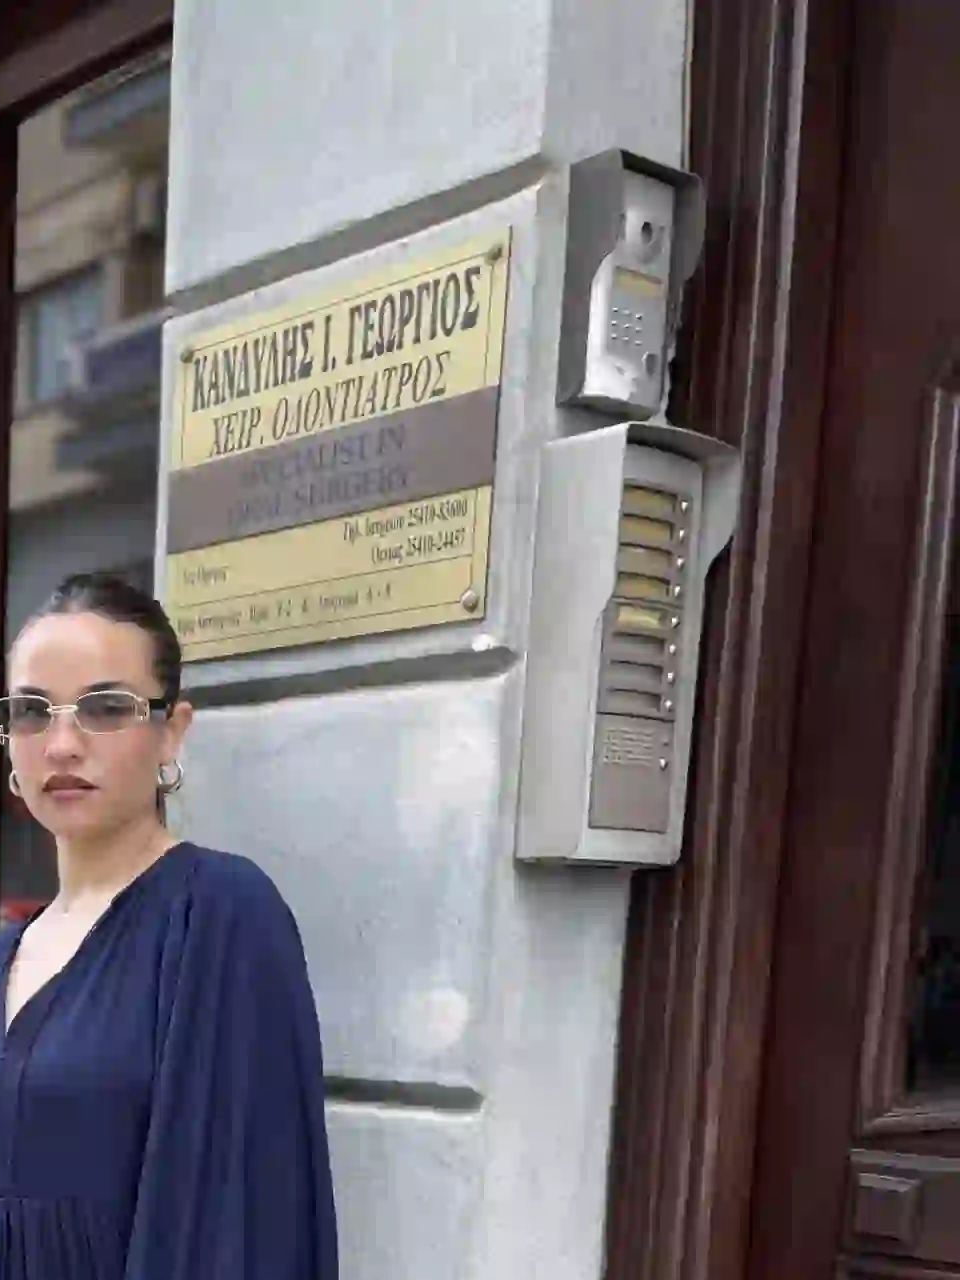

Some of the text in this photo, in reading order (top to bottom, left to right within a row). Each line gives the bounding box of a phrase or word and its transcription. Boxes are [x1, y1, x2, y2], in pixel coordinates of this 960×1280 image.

[192, 266, 481, 412] ΚΑΝΔΥΛΗΣ Ι. ΓΕΩΡΓΙΟΣ
[209, 351, 451, 457] ΧΕΙΡ. ΟΔΟΝΤΙΑΤΡΟΣ
[242, 430, 369, 487] ECIALIST
[227, 490, 282, 529] AL
